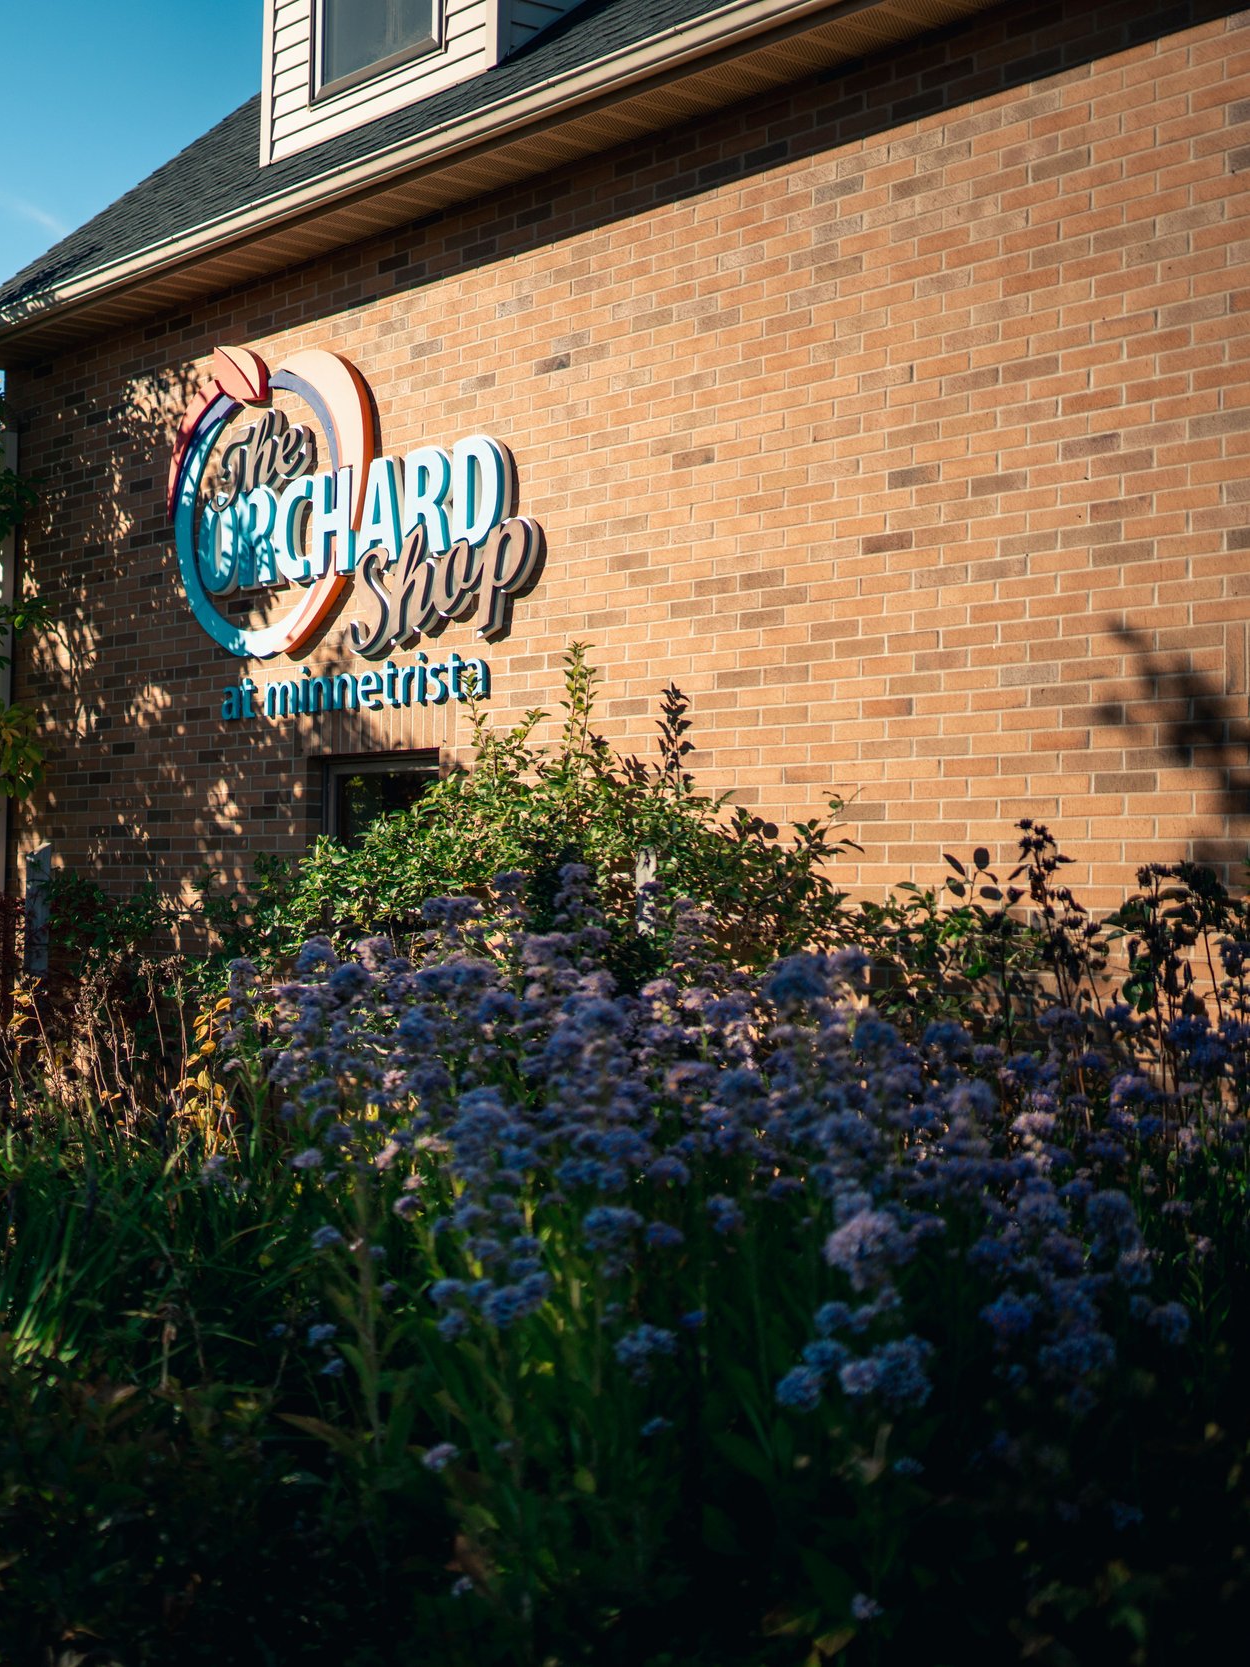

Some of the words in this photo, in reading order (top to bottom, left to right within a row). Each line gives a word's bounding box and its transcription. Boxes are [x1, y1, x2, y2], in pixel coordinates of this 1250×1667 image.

[199, 435, 510, 594] ORCHARD
[220, 409, 312, 511] The
[348, 517, 541, 655] Shop
[221, 678, 257, 721] at
[264, 651, 491, 719] minnetrista
